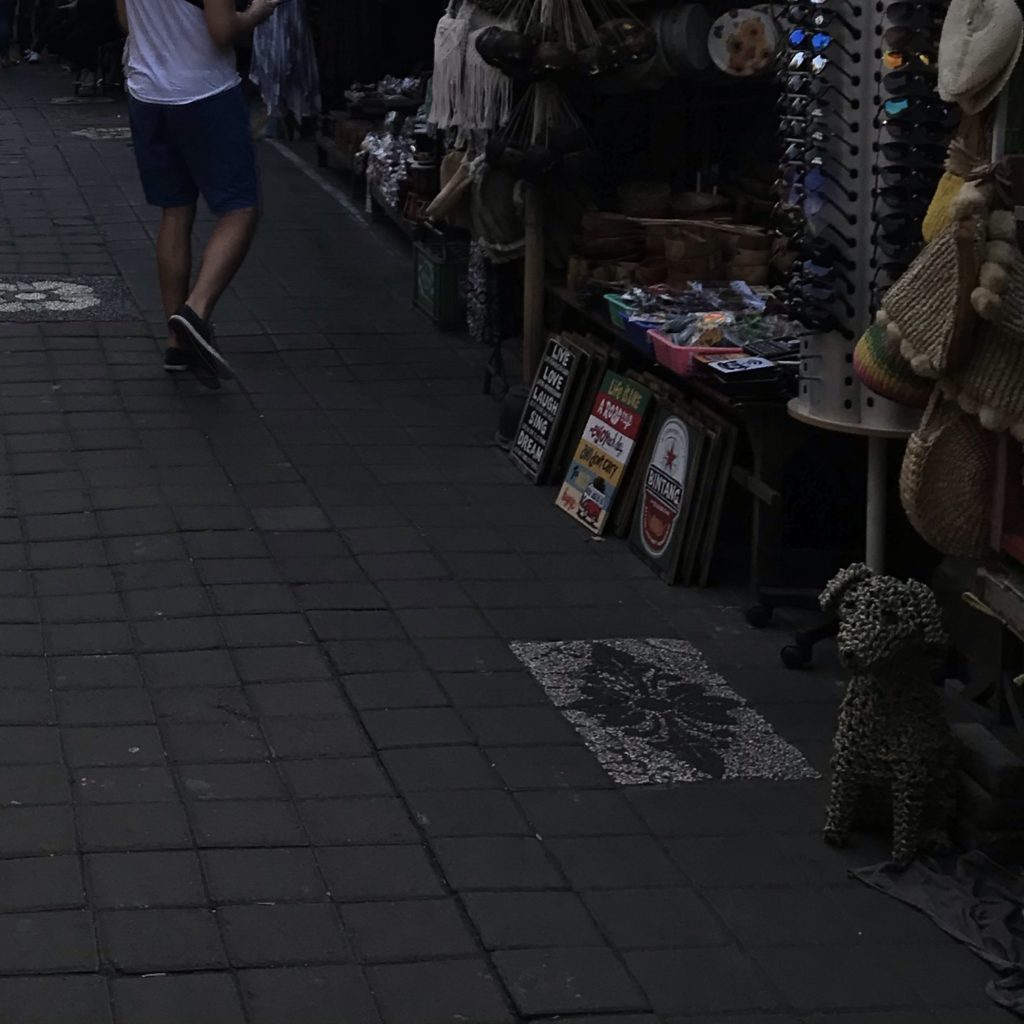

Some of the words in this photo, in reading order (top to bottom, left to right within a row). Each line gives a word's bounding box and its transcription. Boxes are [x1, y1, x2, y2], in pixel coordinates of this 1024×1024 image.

[552, 344, 571, 367] LIVE
[543, 365, 564, 390] LOVE
[532, 386, 561, 416] LAUGH
[528, 409, 549, 436] SING
[517, 430, 544, 463] DREAM
[647, 469, 682, 505] BINTANG
